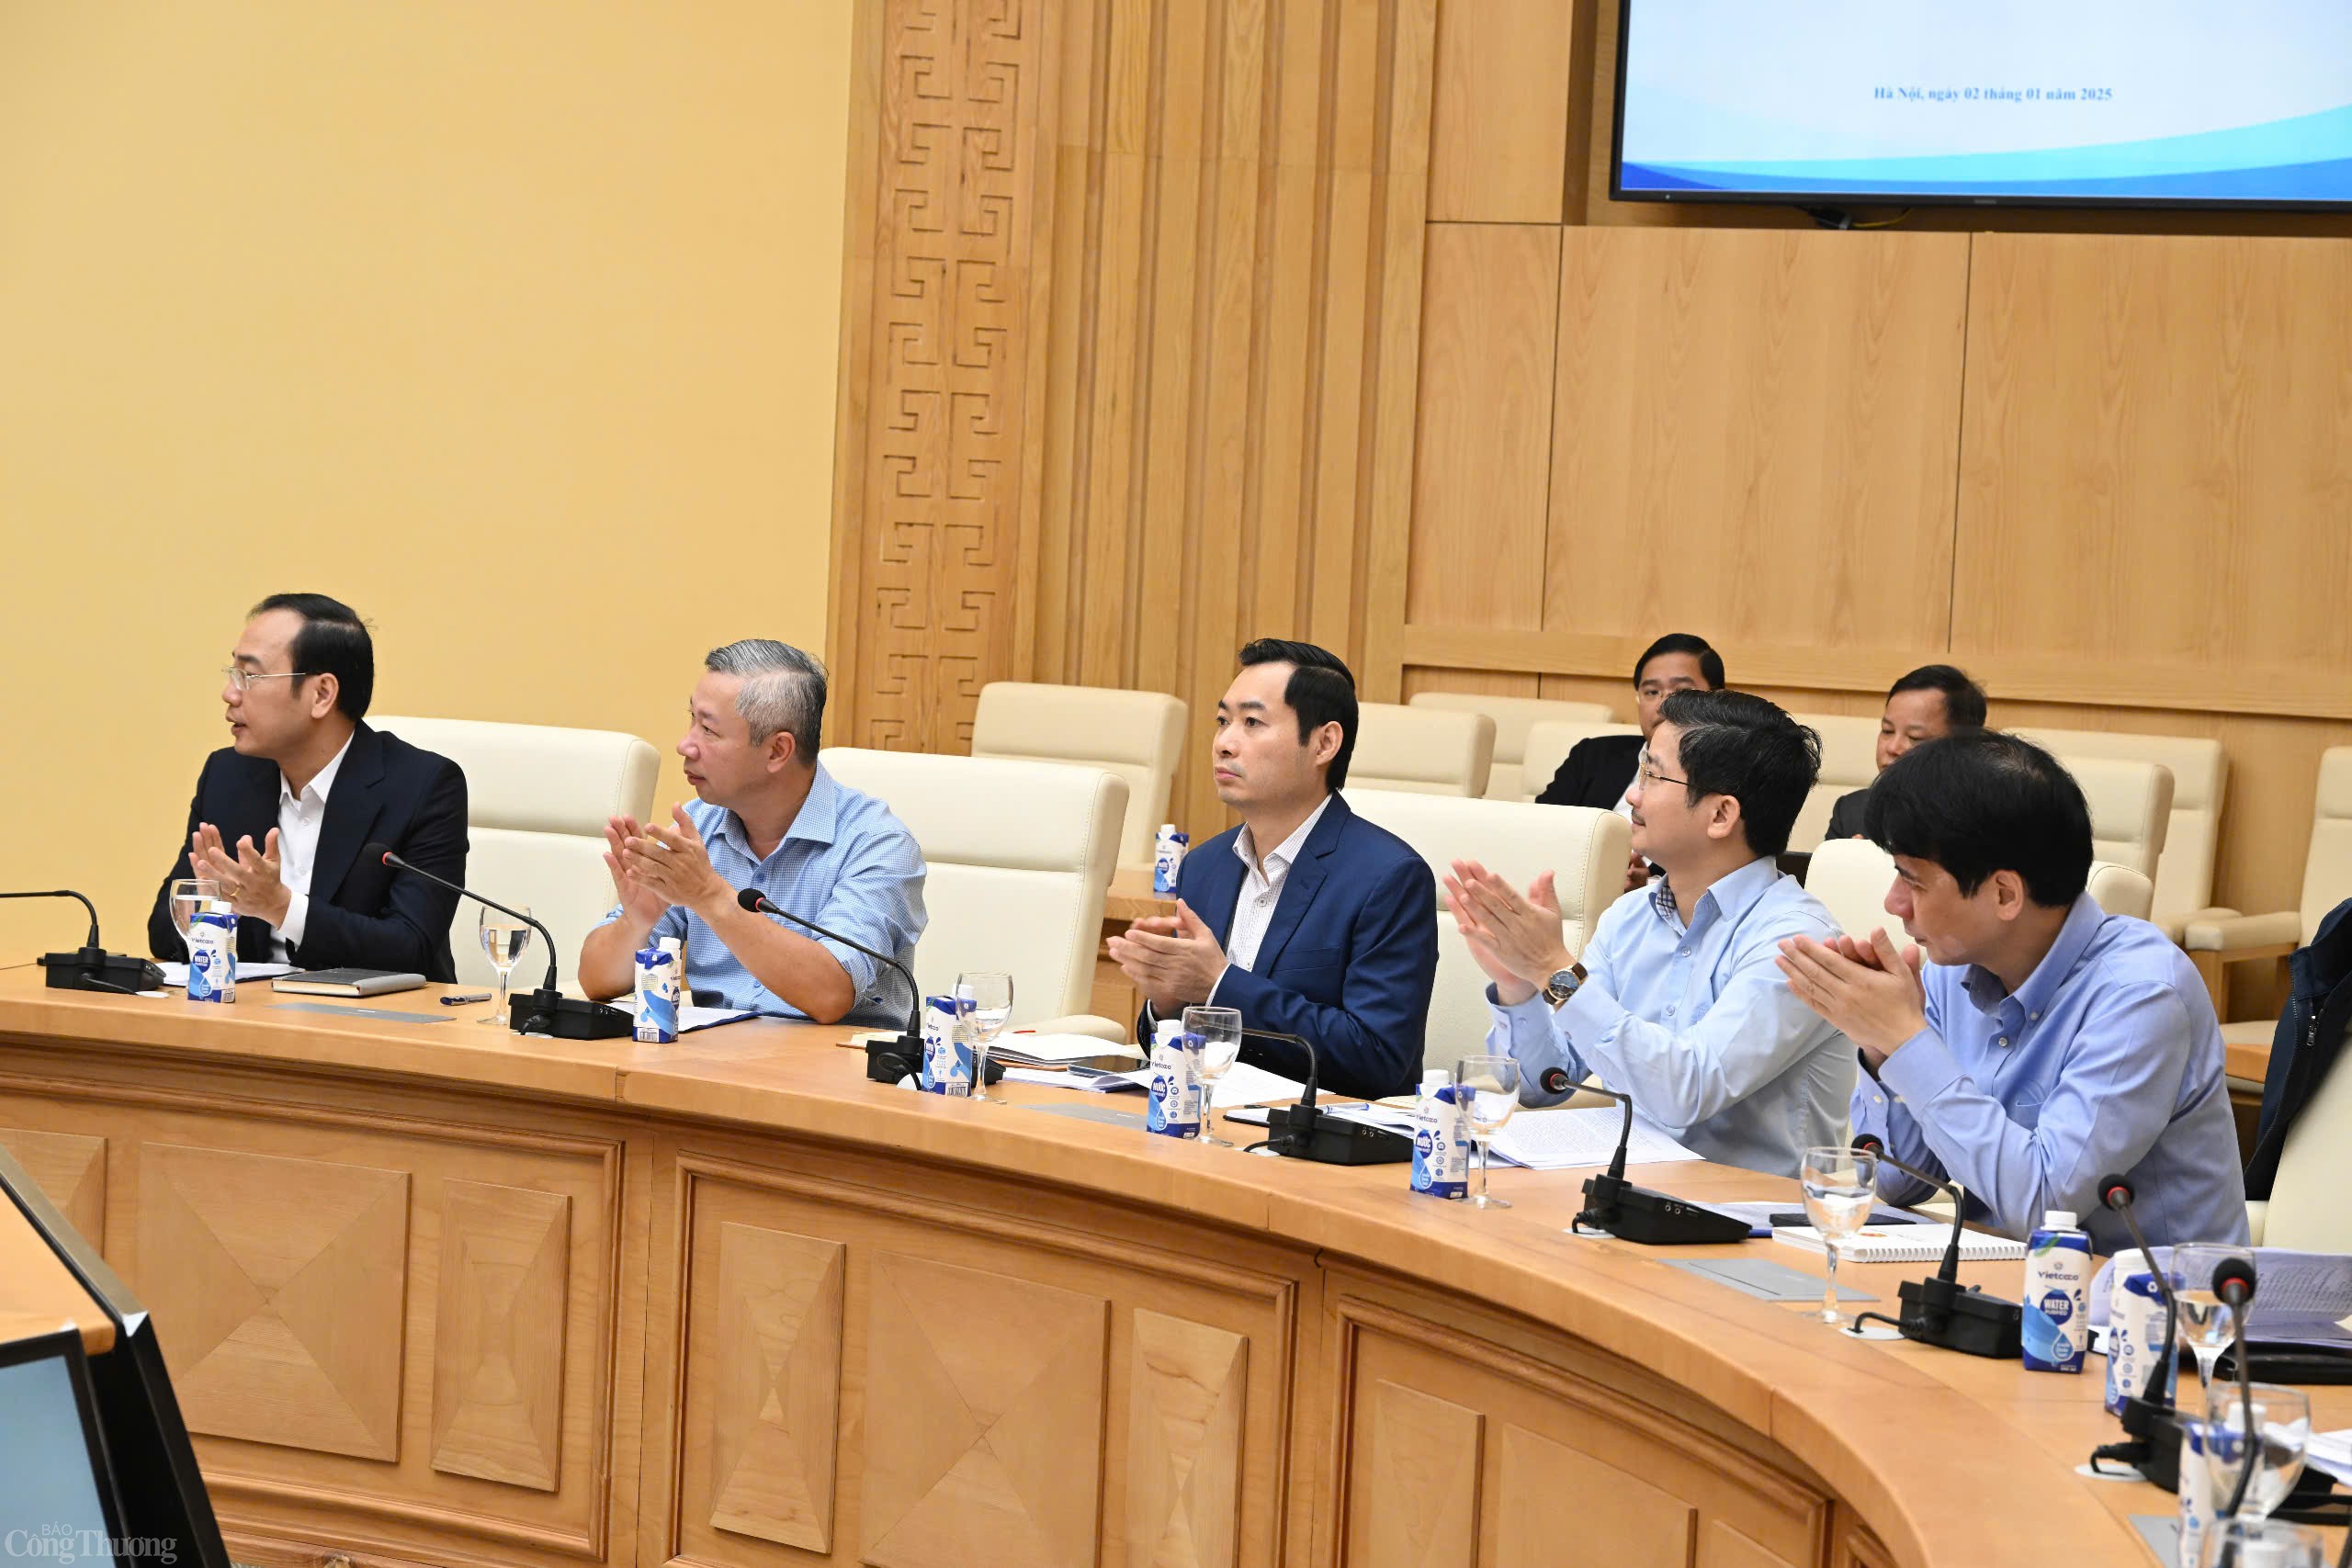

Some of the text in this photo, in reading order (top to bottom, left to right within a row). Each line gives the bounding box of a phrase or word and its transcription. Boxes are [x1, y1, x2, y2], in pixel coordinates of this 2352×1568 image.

[1873, 86, 2113, 103] Hà Nội, ngày 02 tháng 01 năm 2025
[2043, 1299, 2070, 1311] WATER
